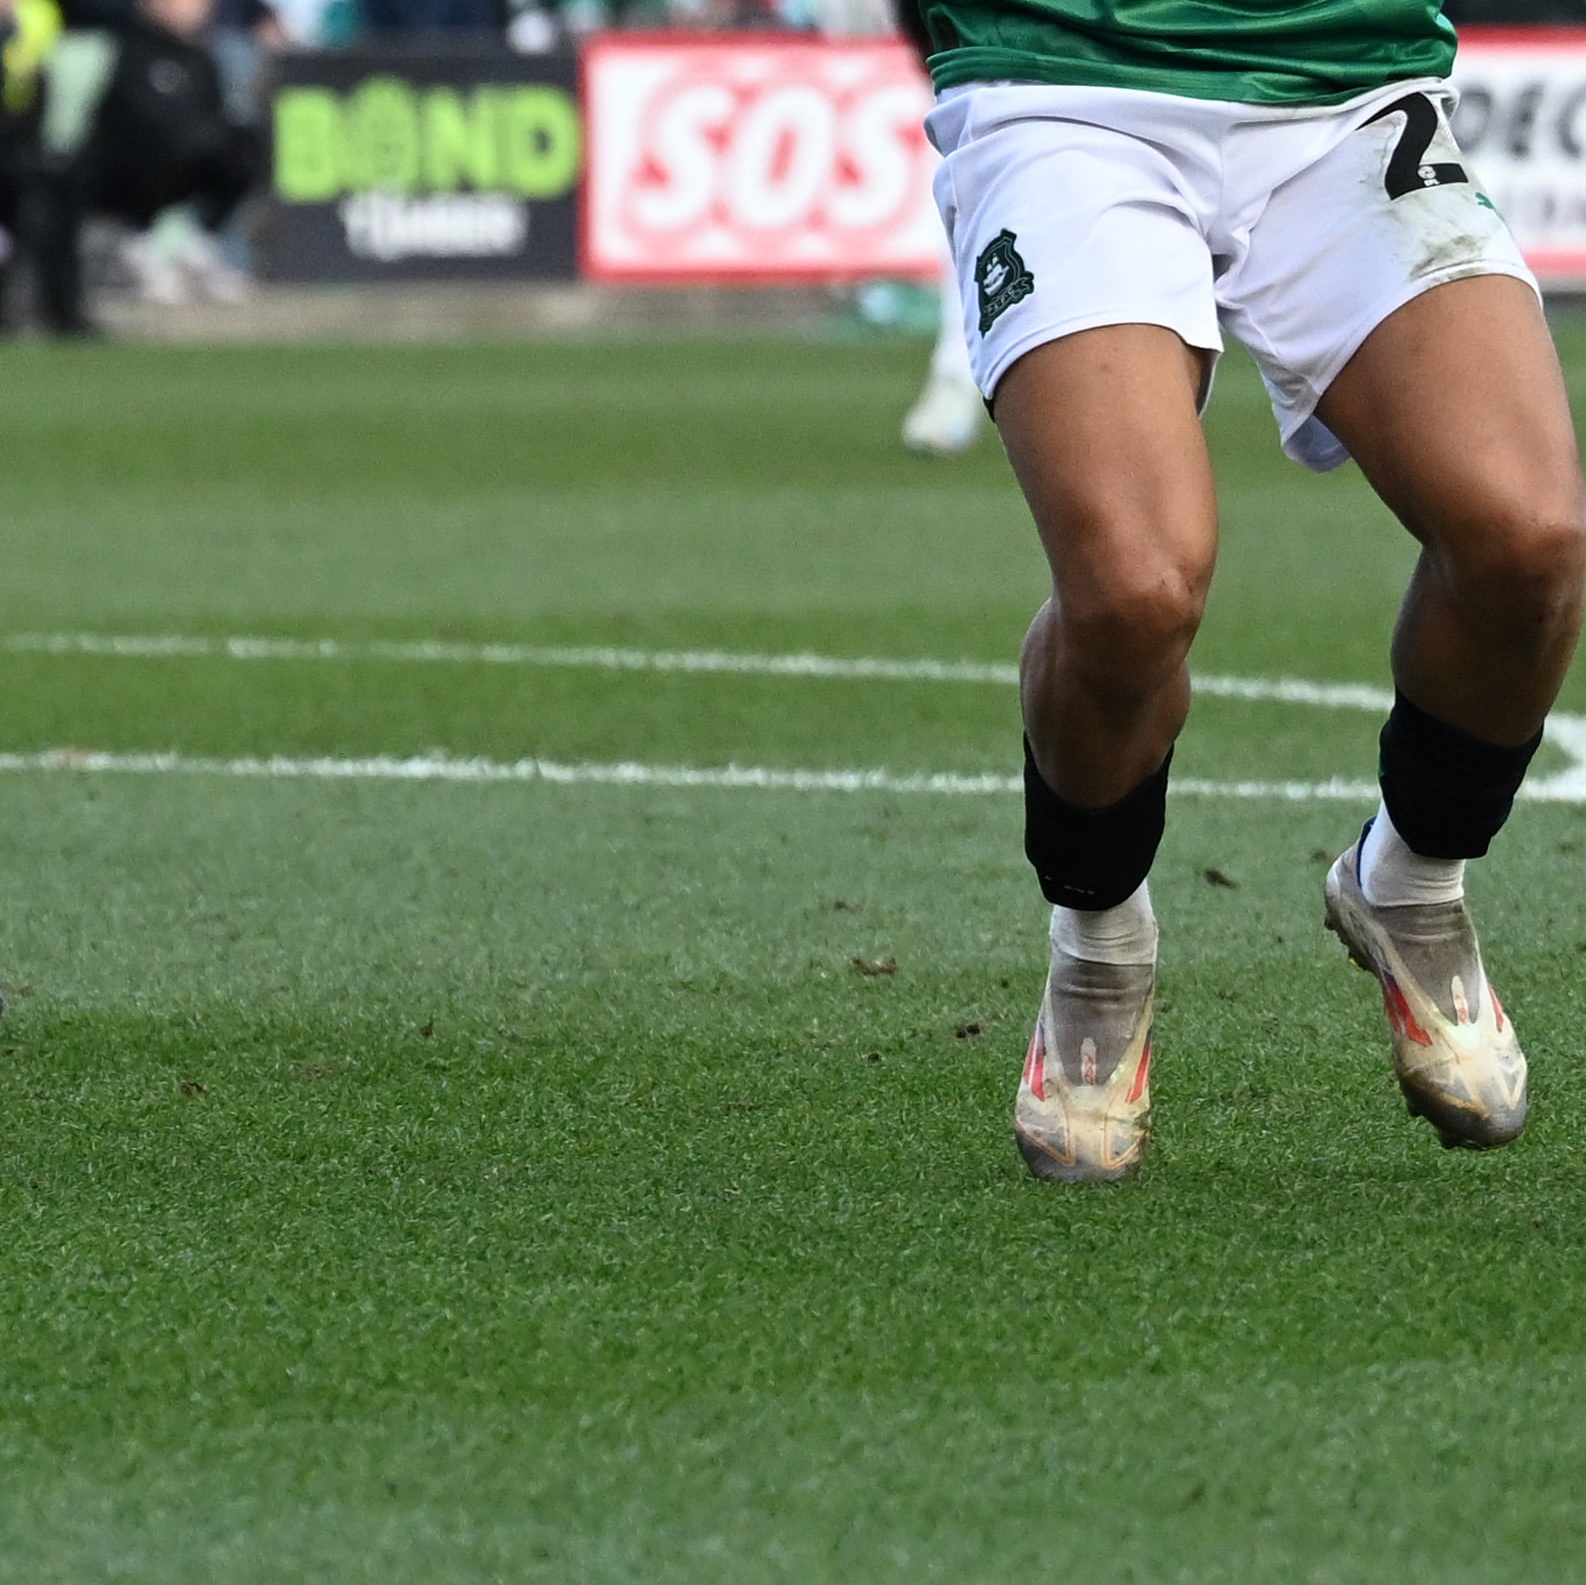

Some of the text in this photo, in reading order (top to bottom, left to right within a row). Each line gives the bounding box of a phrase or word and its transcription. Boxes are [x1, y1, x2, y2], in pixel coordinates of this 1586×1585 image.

[272, 74, 581, 202] BOND
[636, 82, 930, 230] SOS
[1354, 91, 1469, 201] 2
